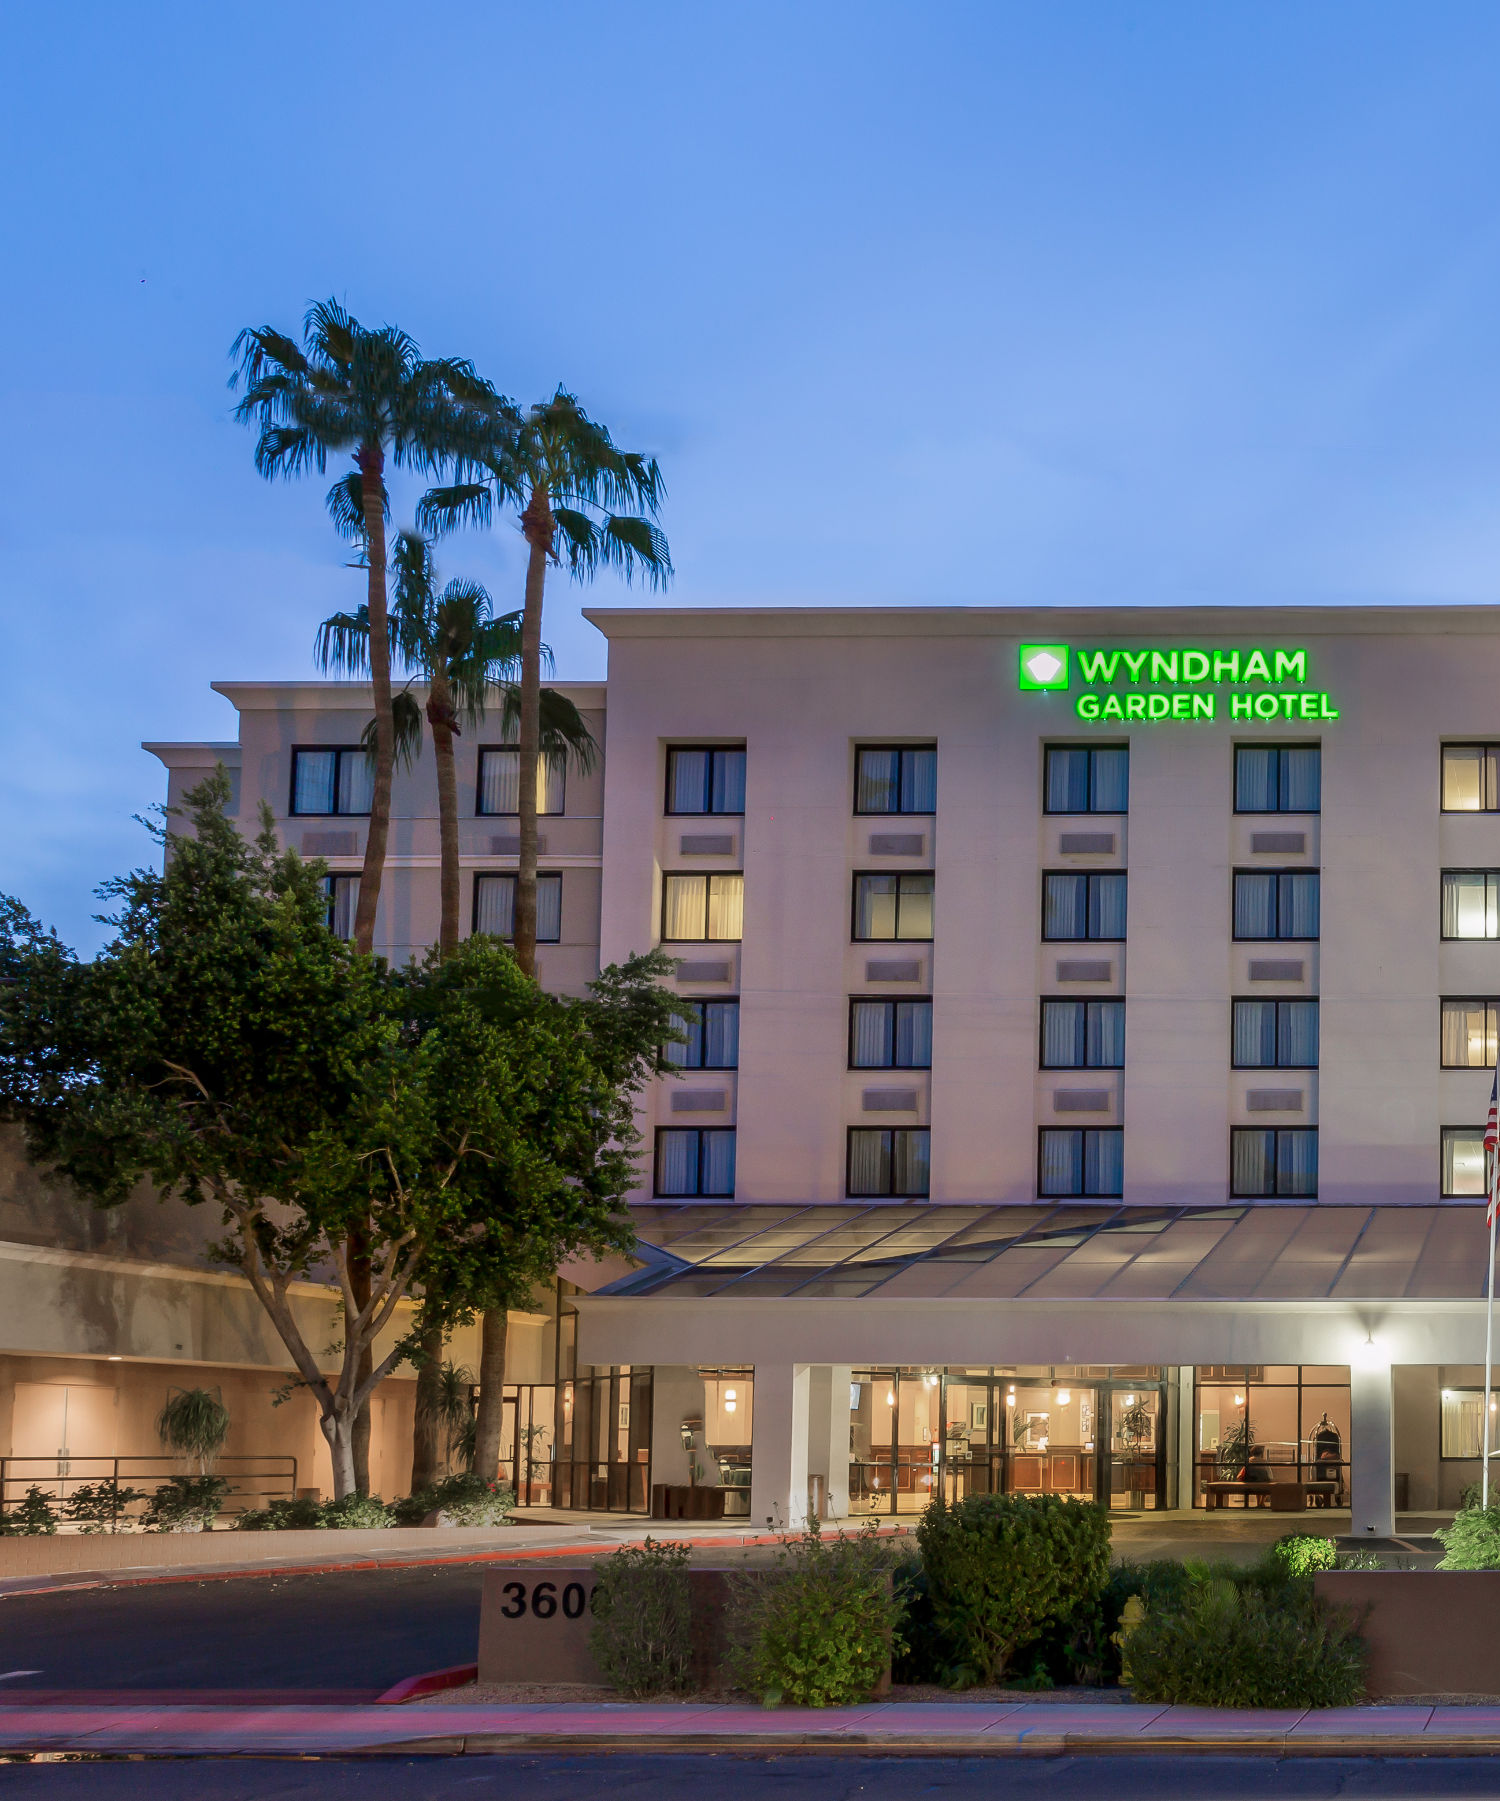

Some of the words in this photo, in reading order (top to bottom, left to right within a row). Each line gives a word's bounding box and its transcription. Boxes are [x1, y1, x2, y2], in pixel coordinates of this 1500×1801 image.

[1077, 650, 1306, 683] WYNDHAM
[1076, 692, 1215, 719] GARDEN
[1230, 692, 1339, 719] HOTEL
